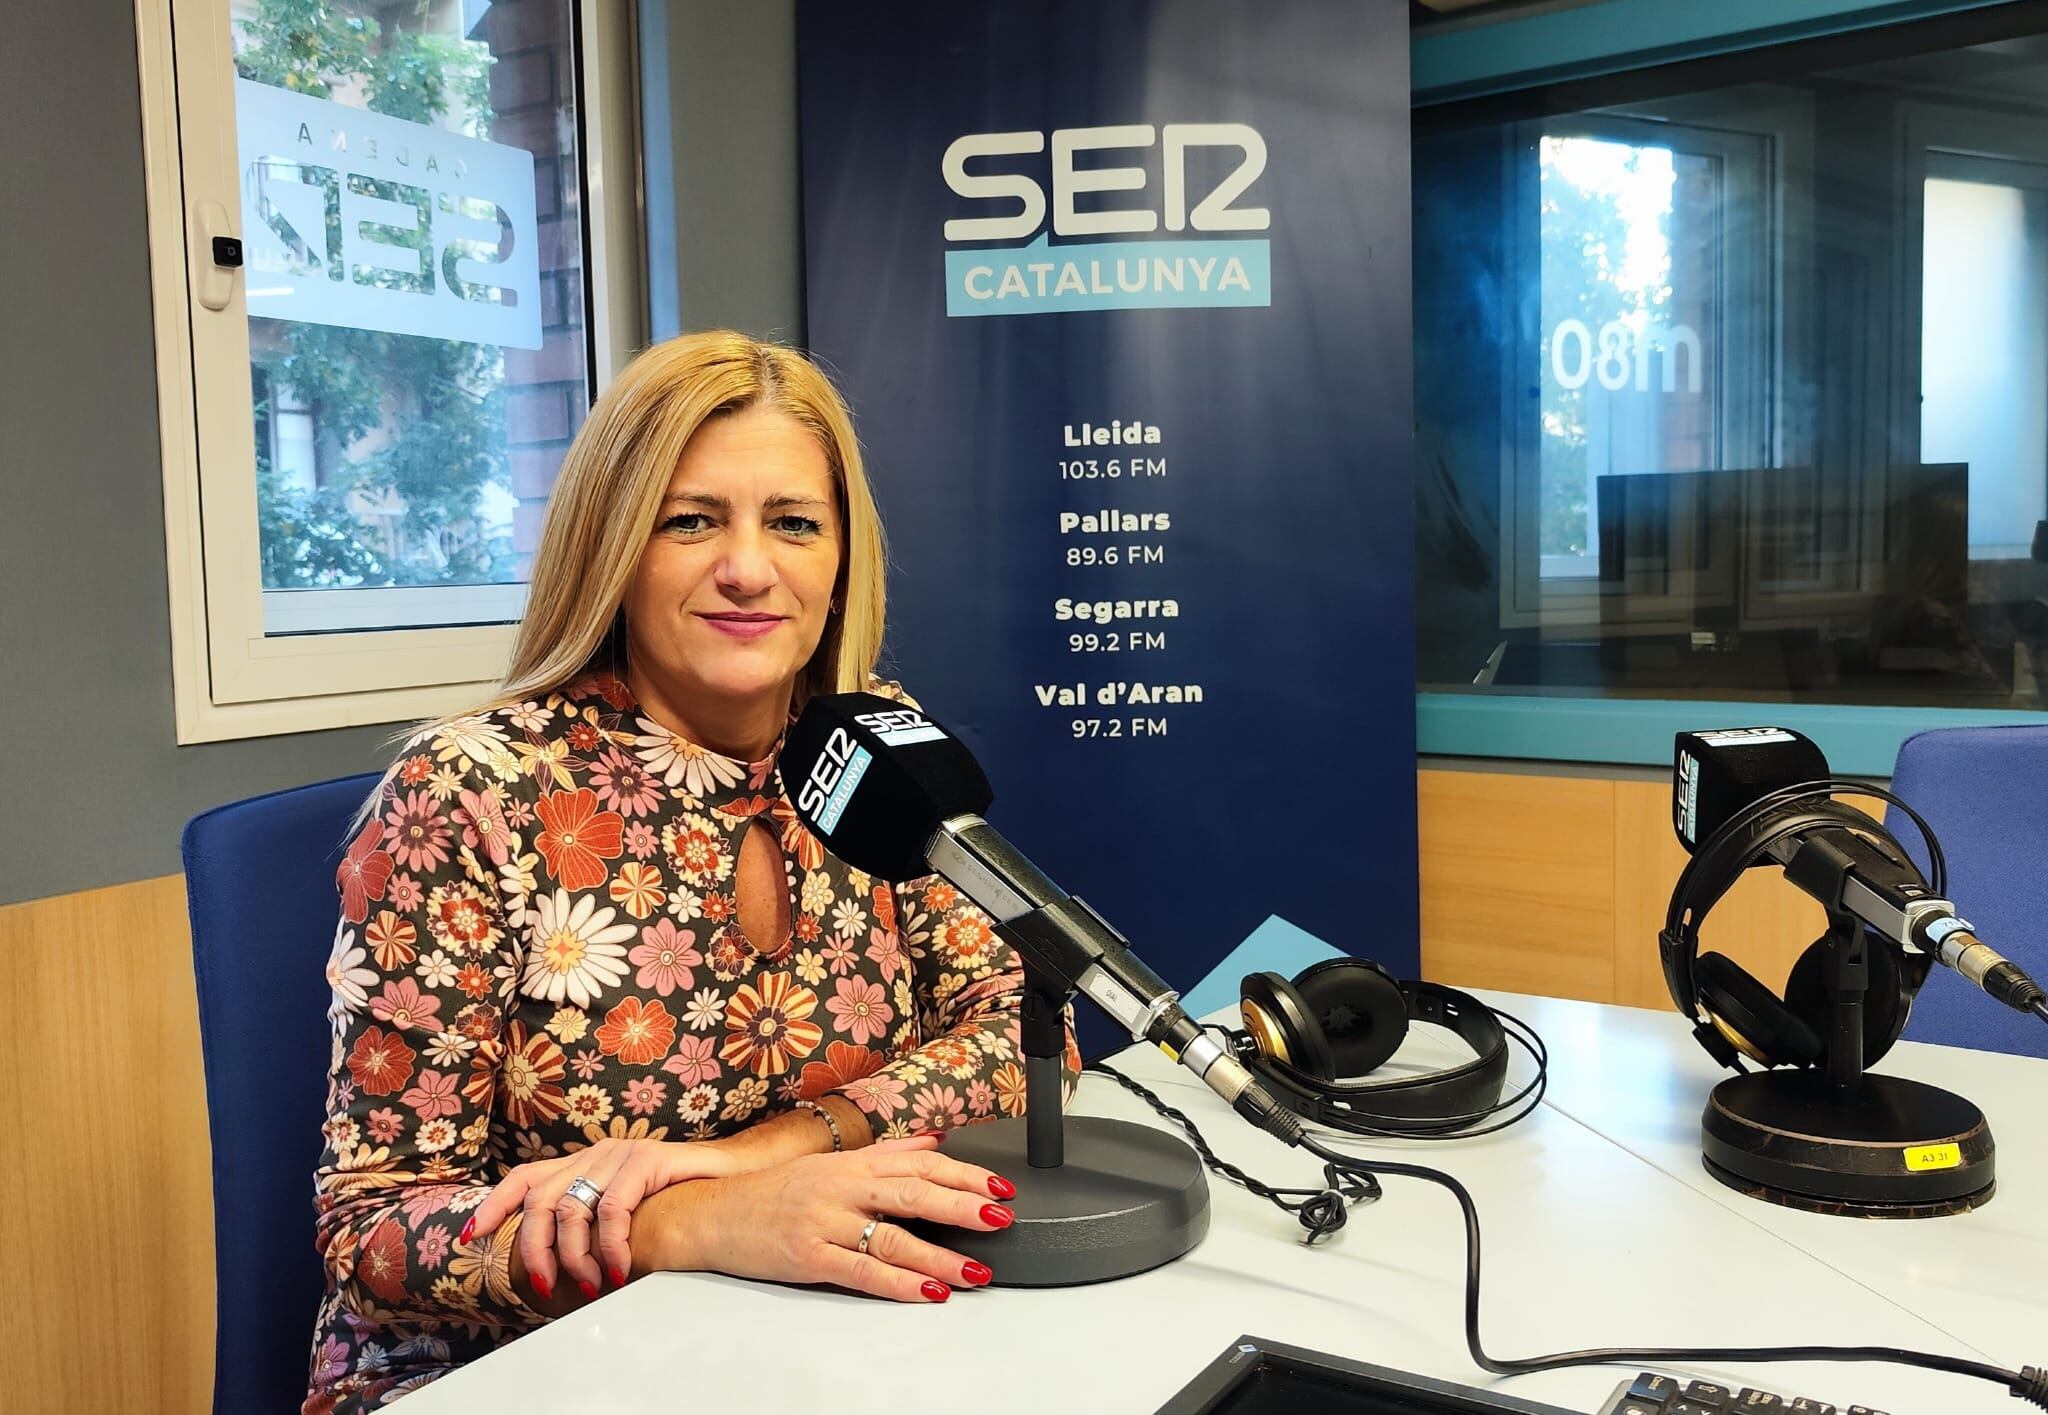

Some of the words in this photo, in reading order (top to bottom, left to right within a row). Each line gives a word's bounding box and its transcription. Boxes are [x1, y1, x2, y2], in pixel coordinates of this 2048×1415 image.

[942, 123, 1271, 241] SER
[964, 257, 1252, 300] CATALUNYA
[1064, 420, 1161, 447] Lleida
[1058, 459, 1122, 480] 103.6
[1130, 458, 1167, 477] FM
[1059, 509, 1171, 533] Pallars
[1066, 547, 1119, 566] 89.6
[1128, 545, 1164, 564] FM
[1055, 599, 1179, 624] Segarra
[1069, 633, 1120, 652] 99.2
[1129, 632, 1165, 650] FM
[1034, 683, 1086, 707] Val
[1097, 682, 1203, 705] d'Aran
[854, 709, 933, 734] SER
[1071, 719, 1122, 738] 97.2
[1131, 718, 1167, 737] FM
[798, 727, 858, 822] SER
[823, 755, 867, 829] CATALUNYA
[1677, 749, 1691, 836] SER
